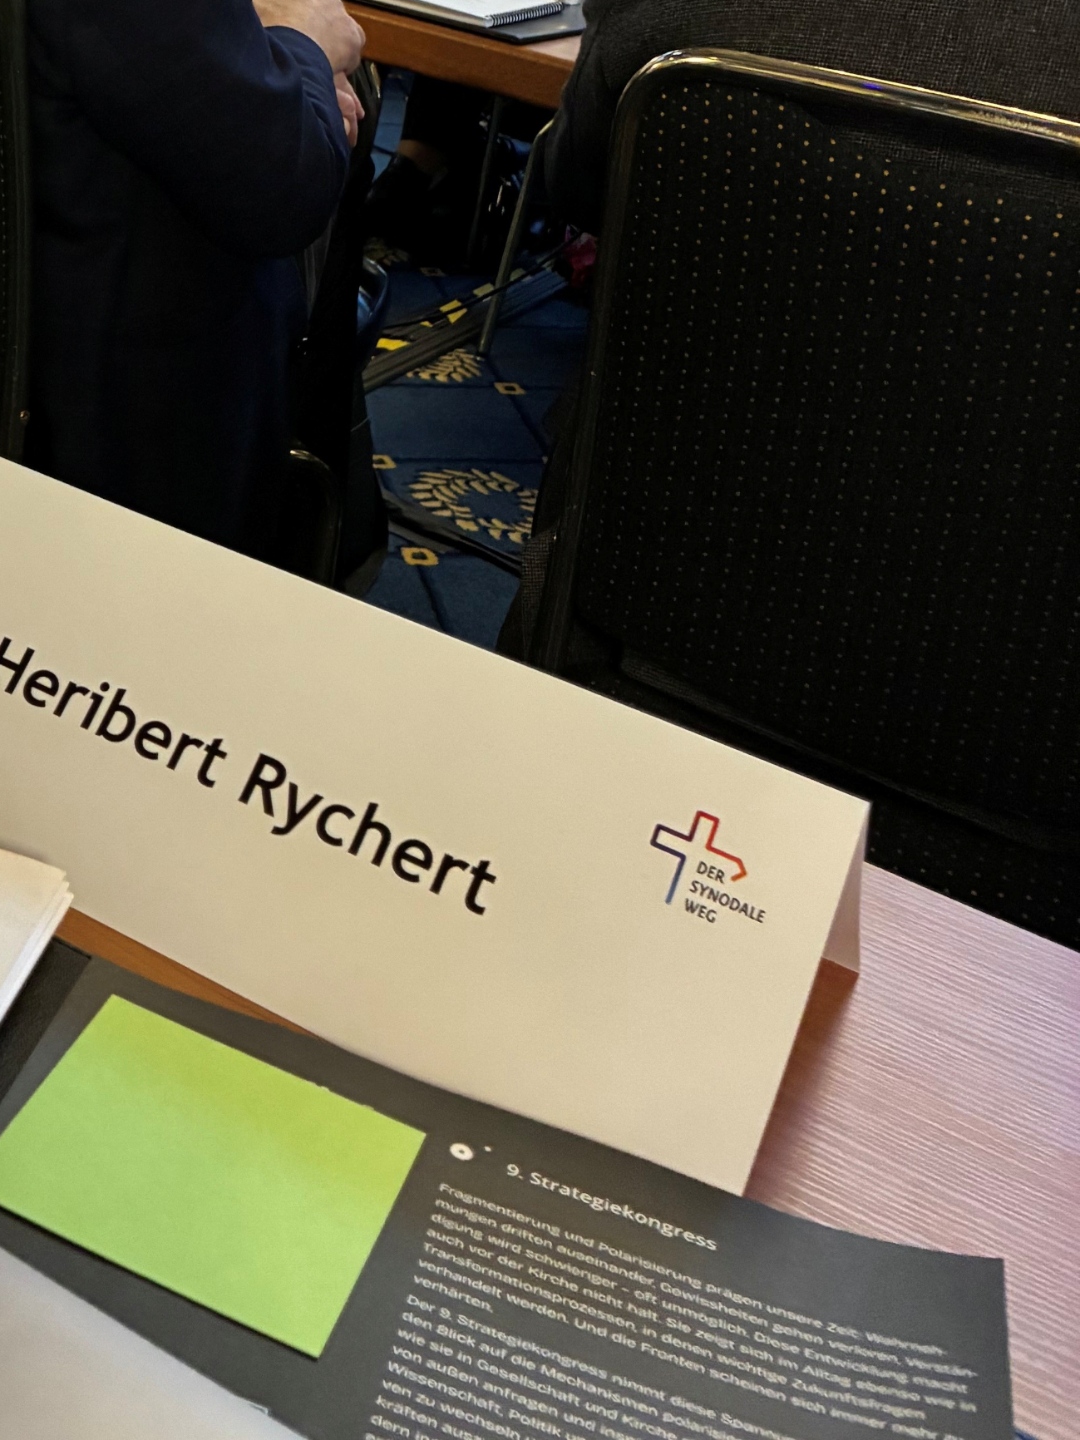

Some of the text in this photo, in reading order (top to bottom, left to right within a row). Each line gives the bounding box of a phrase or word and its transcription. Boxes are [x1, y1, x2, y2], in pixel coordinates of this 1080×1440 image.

[238, 753, 498, 917] Rychert
[696, 861, 725, 884] DER
[685, 898, 717, 923] WEG
[689, 880, 766, 923] SYNODALE
[439, 1183, 560, 1237] Fragmentierung
[565, 1231, 594, 1247] und
[598, 1242, 702, 1289] Polarisierung
[766, 1305, 823, 1328] unsere
[507, 1164, 716, 1250] 9. Strategiekongress
[419, 1259, 502, 1298] verhandelt
[574, 1318, 607, 1337] Und
[611, 1333, 636, 1348] die
[641, 1343, 705, 1374] Fronten
[427, 1229, 464, 1249] auch
[469, 1245, 494, 1259] vor
[497, 1256, 523, 1270] der
[528, 1266, 578, 1292] Kirche
[583, 1288, 623, 1308] nicht
[666, 1318, 691, 1333] Sie
[695, 1330, 735, 1350] zeigt
[740, 1345, 773, 1362] sich
[431, 1214, 483, 1240] digung
[488, 1235, 521, 1254] wird
[525, 1249, 617, 1289] schwieriger
[634, 1291, 657, 1304] oft
[754, 1332, 800, 1353] Diese
[435, 1200, 497, 1227] mungen
[501, 1224, 552, 1248] driften
[660, 1283, 768, 1327] Gewissheiten
[772, 1324, 823, 1344] gehen
[393, 1346, 422, 1363] von
[426, 1360, 478, 1386] außen
[483, 1382, 558, 1417] anfragen
[563, 1413, 596, 1431] und
[398, 1329, 425, 1346] wie
[430, 1342, 453, 1356] sie
[457, 1351, 472, 1365] in
[477, 1359, 580, 1407] Gesellschaft
[584, 1402, 618, 1420] und
[402, 1313, 432, 1331] den
[436, 1325, 475, 1347] Blick
[479, 1343, 507, 1359] auf
[511, 1355, 536, 1370] die
[541, 1365, 658, 1416] Mechanismen
[407, 1294, 435, 1312] Der
[440, 1308, 451, 1320] 9.
[457, 1315, 607, 1379] Strategiekongress
[612, 1376, 665, 1401] nimmt
[642, 1326, 657, 1338] in
[661, 1334, 712, 1359] denen
[383, 1380, 411, 1398] ven
[416, 1394, 435, 1407] zu
[440, 1403, 520, 1440] wechseln
